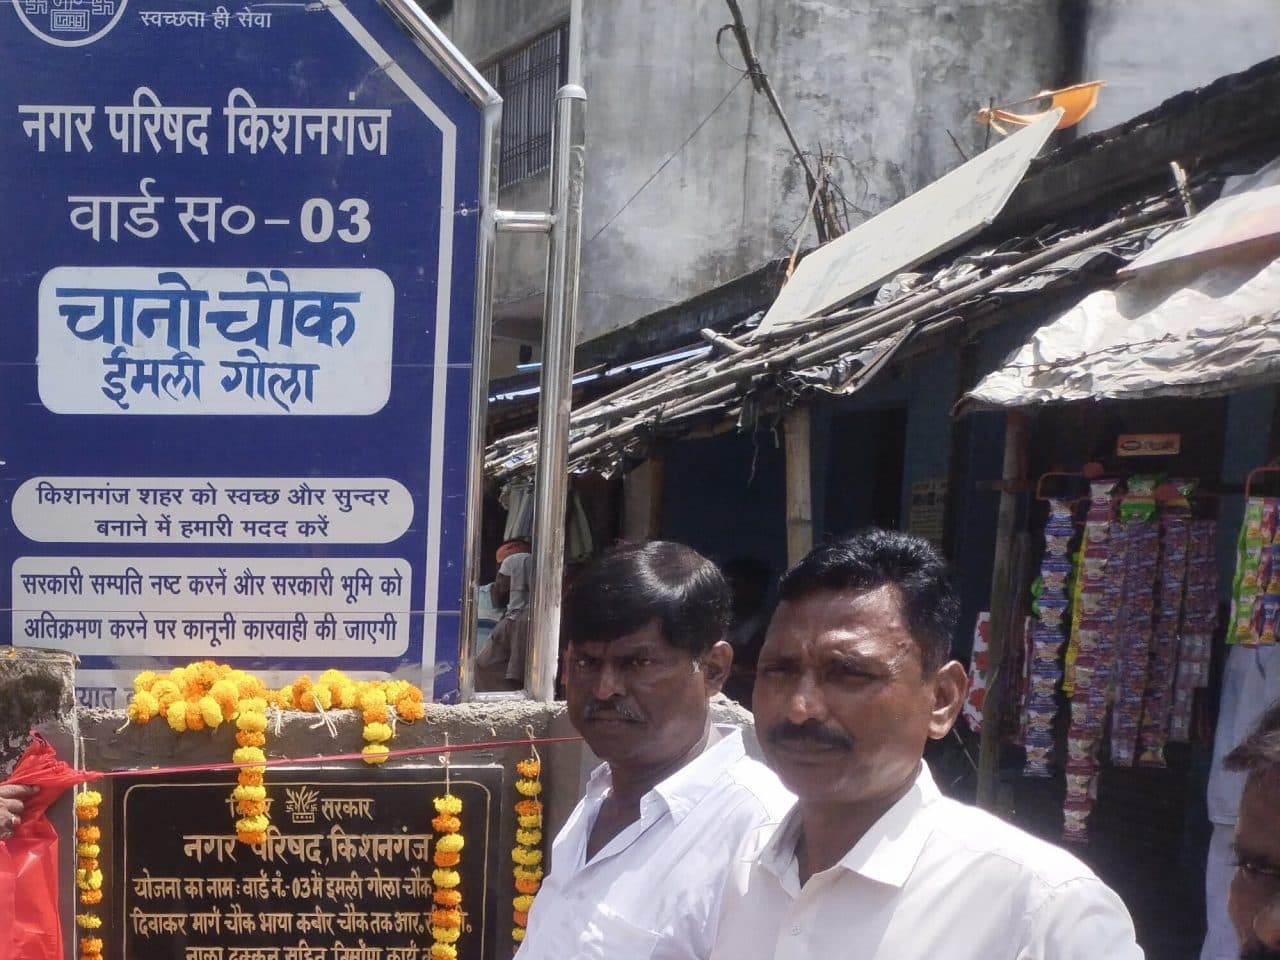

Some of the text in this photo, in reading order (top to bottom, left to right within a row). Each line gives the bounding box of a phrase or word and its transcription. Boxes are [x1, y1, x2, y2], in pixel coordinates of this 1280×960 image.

[139, 6, 272, 30] स्वच्छता ही सेवा
[19, 105, 96, 153] नगर
[104, 87, 212, 155] परिषद
[68, 178, 164, 242] वार्ड
[219, 350, 320, 412] गोला
[37, 481, 389, 512] किशनगंज शहर को स्वच्छ और सुन्दर
[95, 515, 147, 538] बनाने
[180, 514, 232, 538] हमारी
[241, 519, 287, 539] मदद
[298, 514, 329, 538] करें
[21, 566, 84, 597] सरकारी
[150, 574, 182, 597] नष्ट
[234, 568, 265, 598] और
[272, 568, 333, 597] सरकारी
[340, 568, 374, 603] भूमि
[379, 568, 402, 597] को
[24, 611, 397, 647] अतिक्रमण करने पर कानूनी कारवाही की जाएगी
[321, 799, 375, 820] सरकार
[183, 834, 237, 863] नगर
[328, 825, 433, 863] किशनगंज
[132, 868, 181, 899] योजना
[184, 878, 204, 899] का
[242, 869, 270, 899] वार्ड
[326, 869, 364, 902] इमली
[366, 867, 401, 900] गोला
[130, 907, 188, 938] दिवाकर
[190, 906, 221, 935] मार्ग
[224, 903, 256, 935] चौक
[258, 912, 293, 935] भाया
[296, 905, 336, 936] कबीर
[337, 903, 368, 934] चौक
[370, 913, 391, 934] तक
